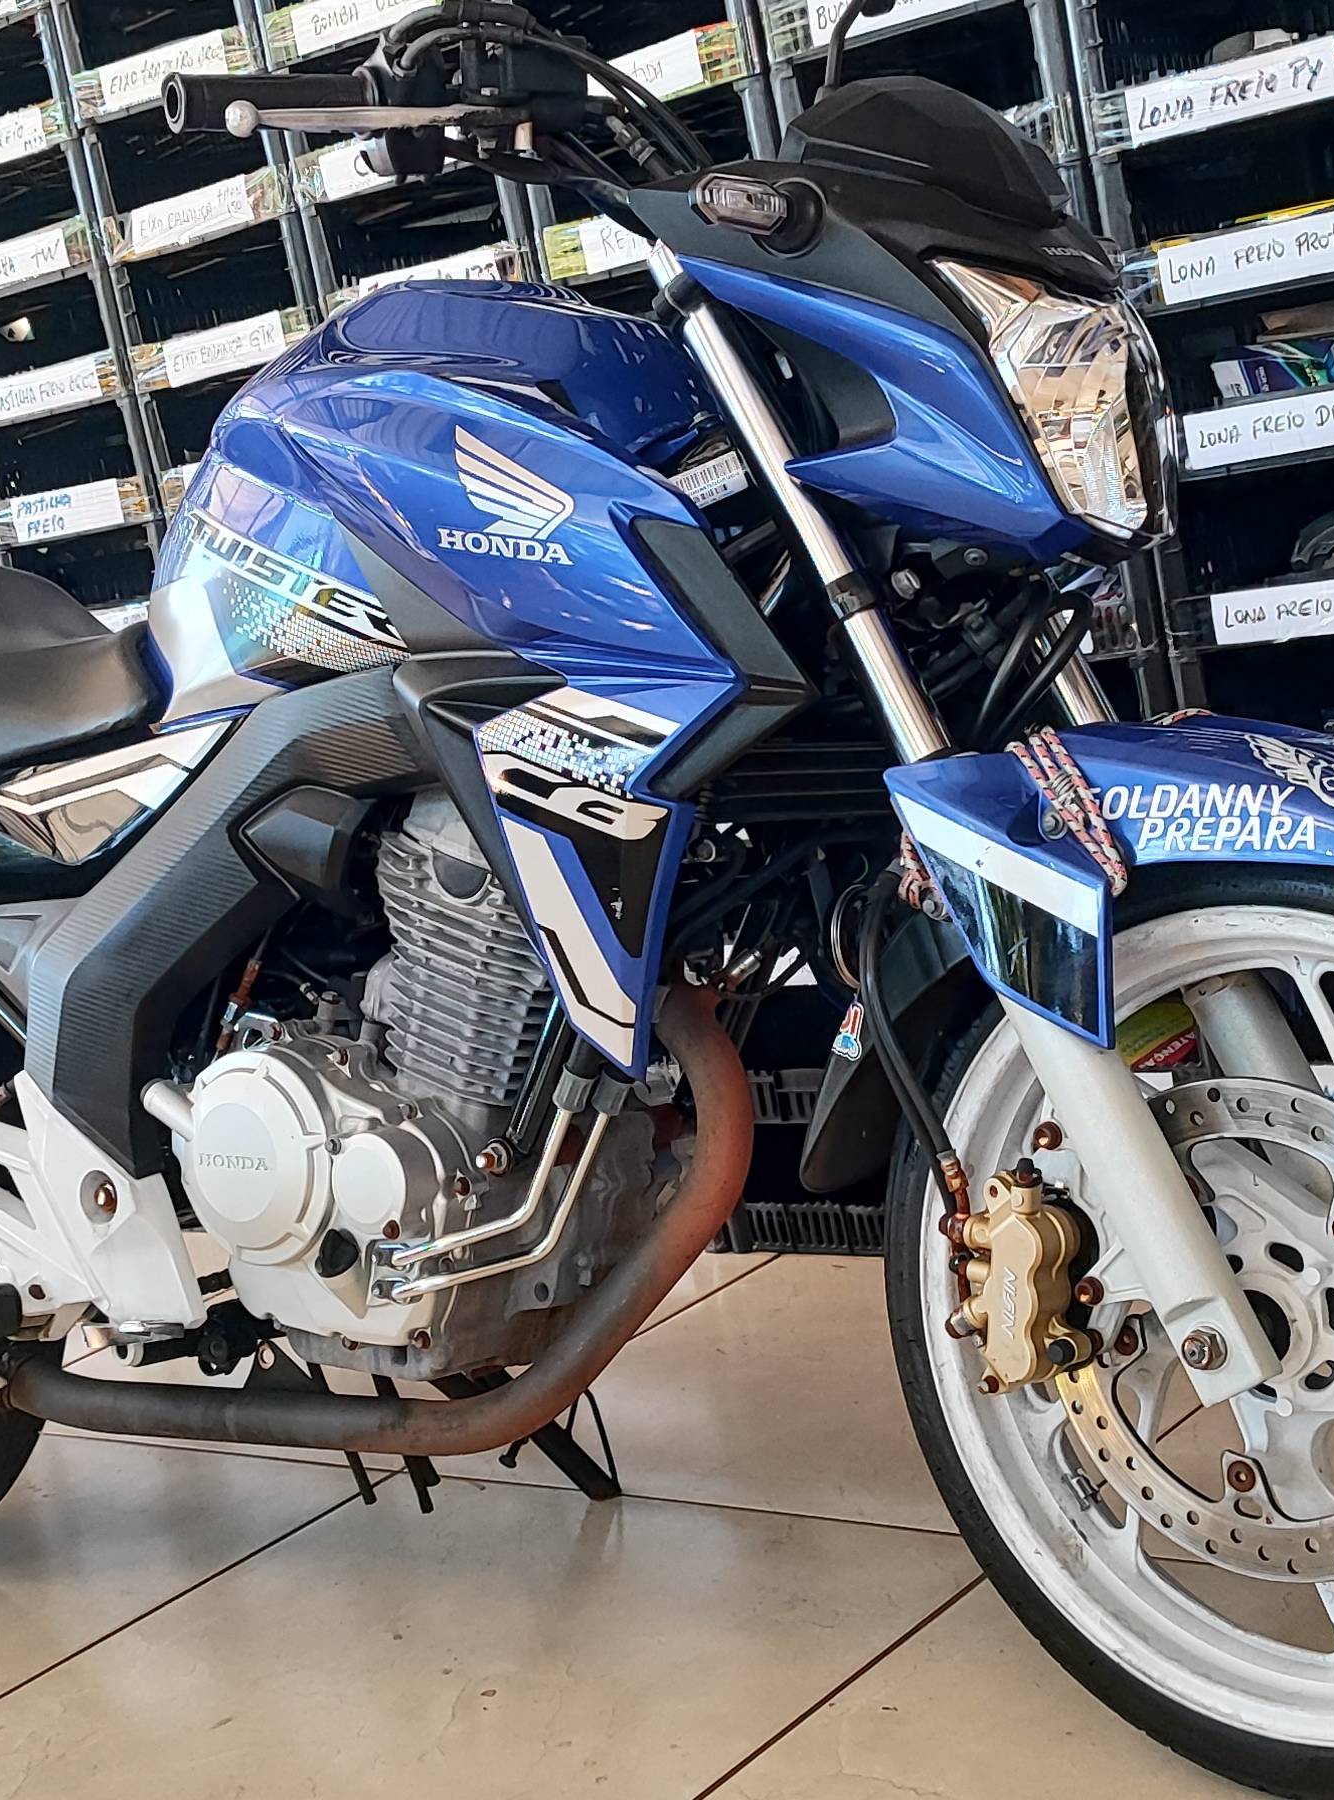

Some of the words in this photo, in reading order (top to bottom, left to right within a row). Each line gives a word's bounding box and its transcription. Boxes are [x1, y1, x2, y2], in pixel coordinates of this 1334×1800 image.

[1138, 96, 1194, 131] LONA
[1209, 70, 1278, 106] FREIO
[1169, 256, 1216, 285] LONA
[1234, 239, 1285, 270] FREIO
[1199, 426, 1242, 448] LONA
[1252, 412, 1305, 438] FREIO
[437, 528, 573, 566] HONDA
[1225, 604, 1267, 628] LONA
[1093, 784, 1295, 820] OLDANNY
[1137, 816, 1316, 852] PREPARA
[198, 1153, 269, 1171] HONDA
